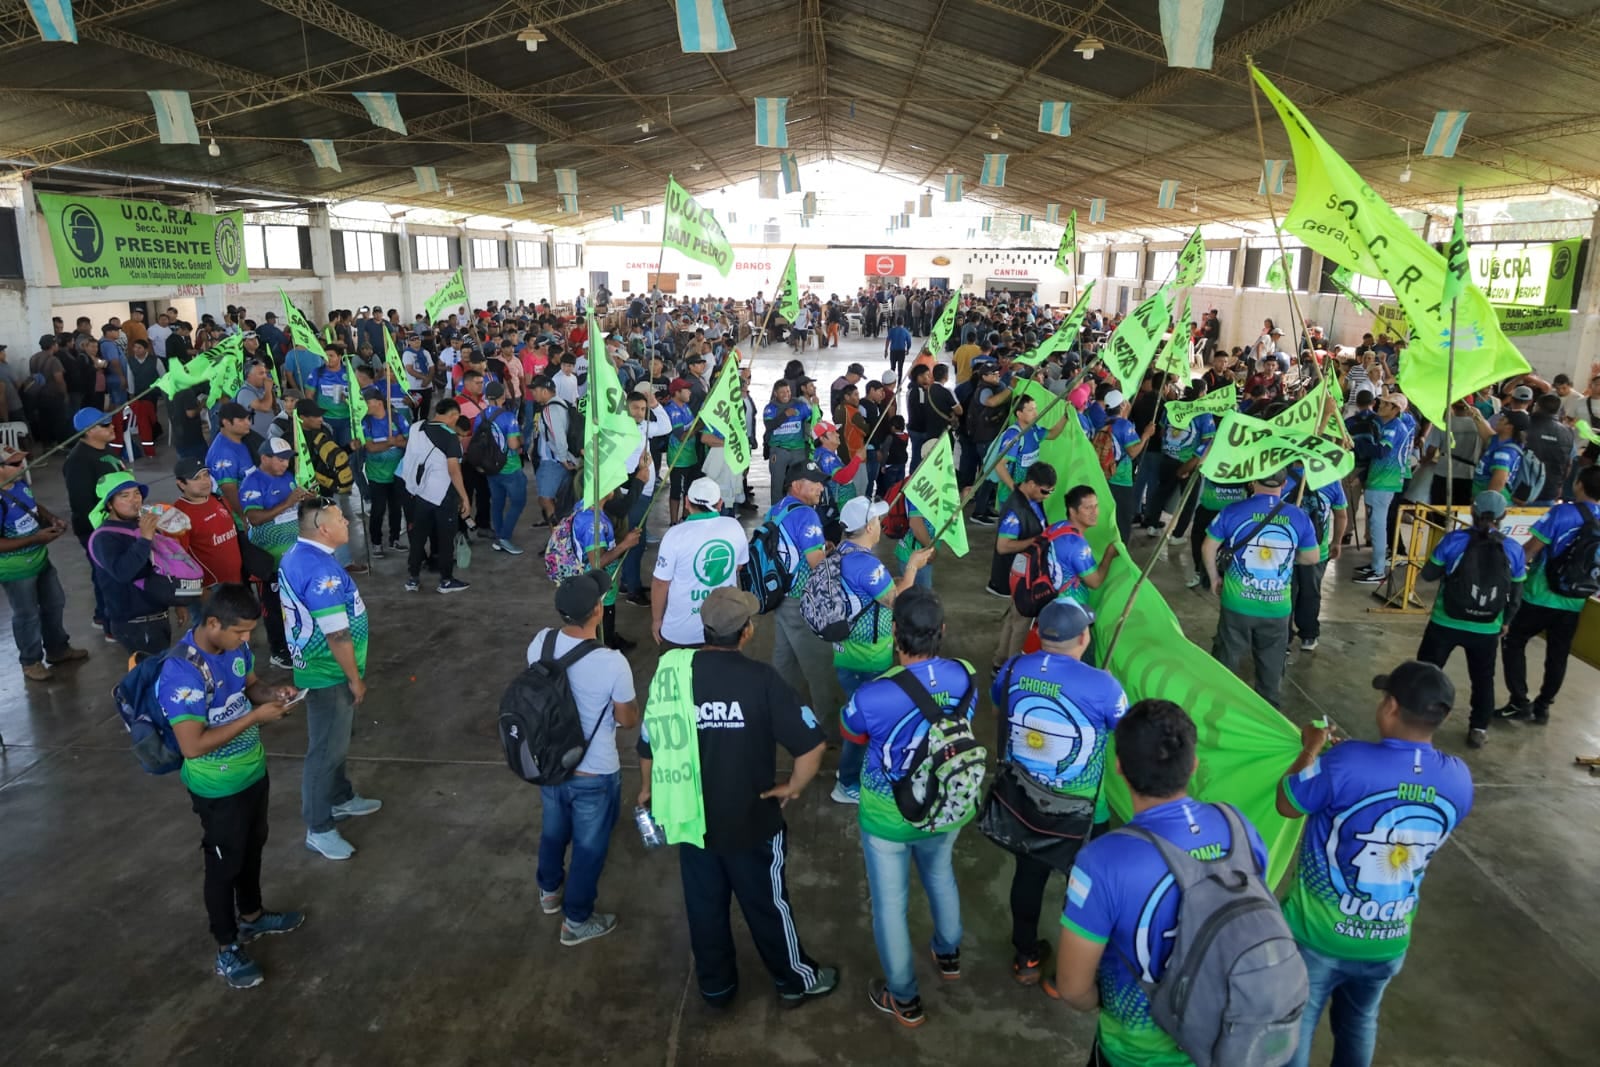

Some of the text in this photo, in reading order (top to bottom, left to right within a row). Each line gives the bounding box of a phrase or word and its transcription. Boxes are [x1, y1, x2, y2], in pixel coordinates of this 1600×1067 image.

[121, 204, 197, 226] U.O.C.R.A.
[135, 222, 188, 236] Secc. JUJUY
[114, 237, 211, 255] PRESENTE
[667, 225, 728, 267] SAN PEDRO
[72, 267, 109, 279] UOCRA
[147, 257, 171, 270] NEYRA
[172, 258, 188, 270] Sec.
[188, 259, 212, 271] General
[626, 262, 660, 270] CANTINA
[1214, 460, 1256, 480] SAN
[1252, 512, 1290, 525] MAANO
[1397, 783, 1436, 803] RULO
[1335, 922, 1409, 940] SAN PEDRO
